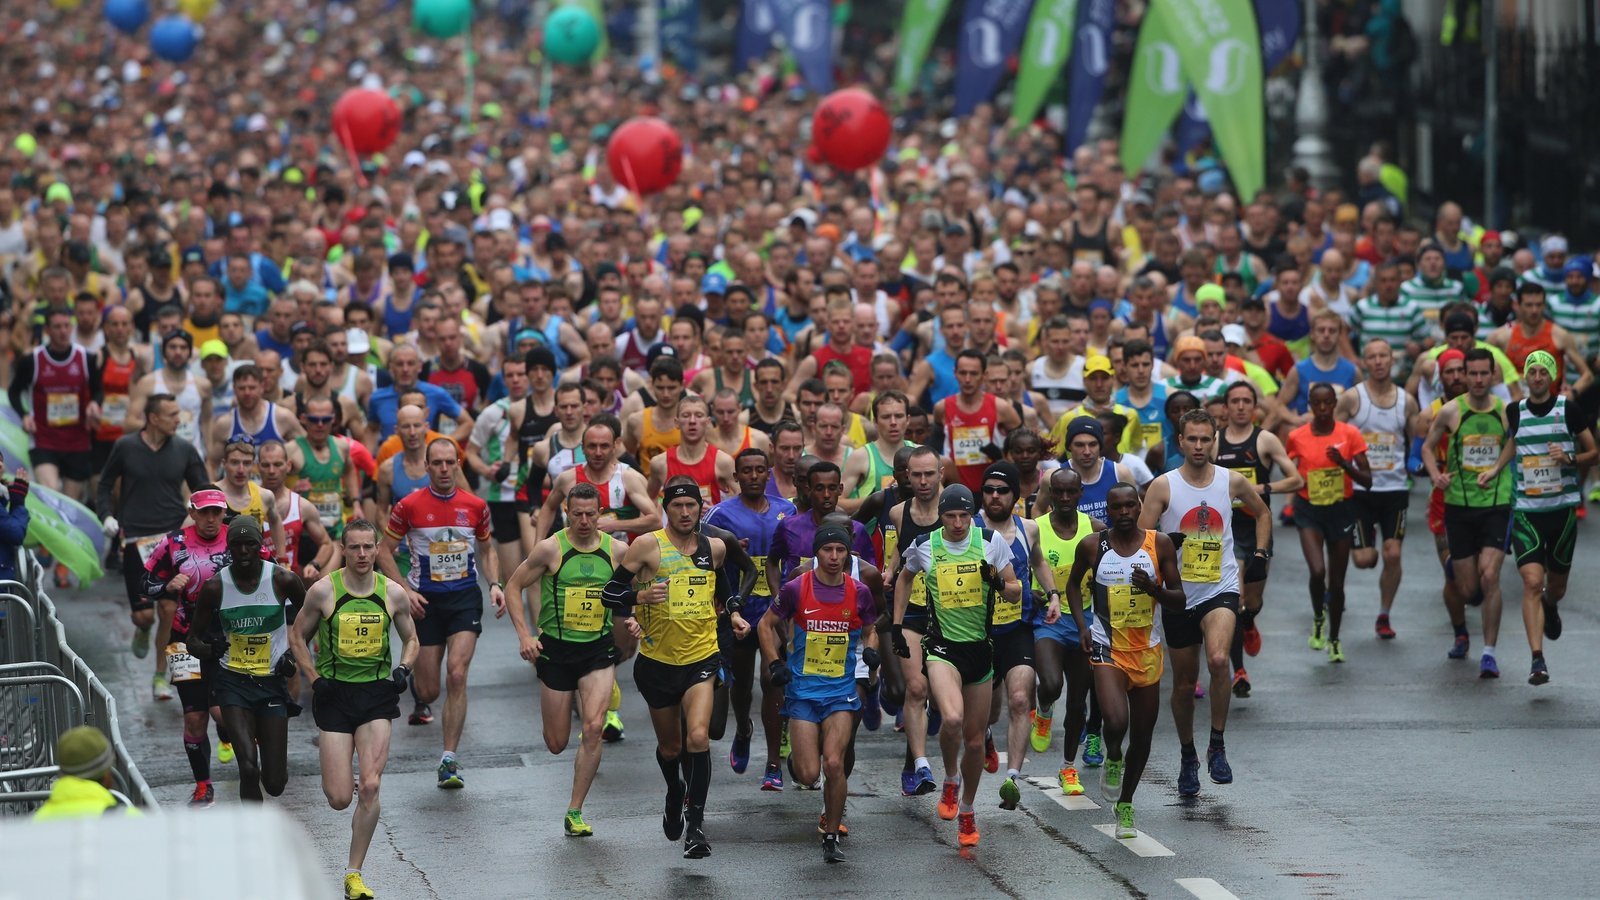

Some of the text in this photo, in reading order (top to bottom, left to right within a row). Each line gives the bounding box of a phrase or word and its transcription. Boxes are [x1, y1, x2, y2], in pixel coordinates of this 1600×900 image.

[1469, 446, 1493, 455] 6463
[1533, 468, 1549, 477] 911
[1318, 479, 1334, 488] 107
[437, 554, 462, 563] 3614
[1197, 553, 1209, 562] 17
[956, 577, 963, 587] 6
[687, 588, 695, 598] 9
[581, 602, 592, 611] 12
[1129, 599, 1136, 608] 5
[230, 617, 265, 629] RAHENY
[806, 619, 850, 632] RUSSIA
[355, 627, 369, 636] 18
[243, 647, 256, 656] 15
[824, 647, 831, 657] 7
[169, 652, 192, 664] 3522
